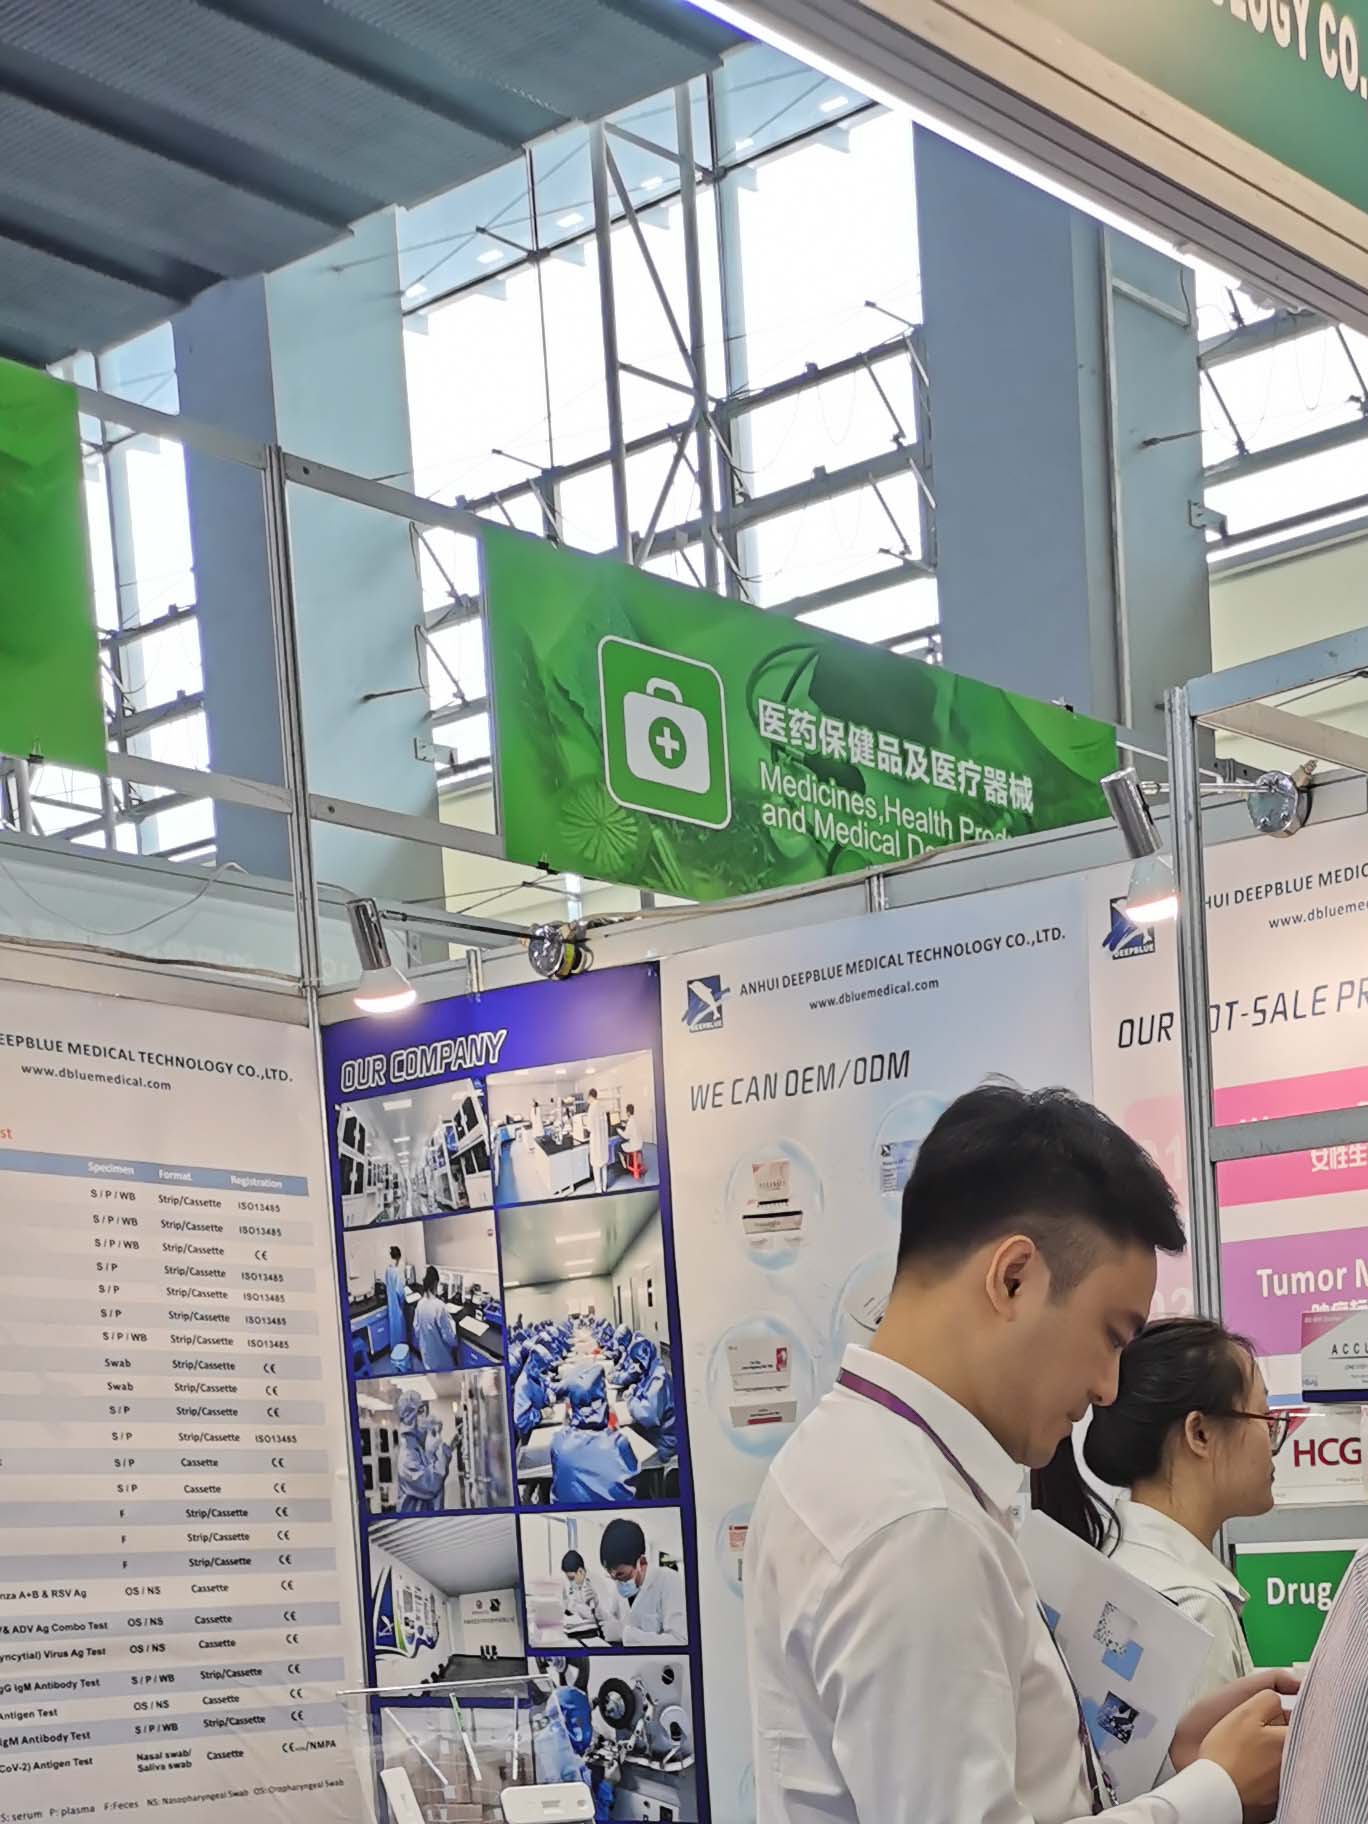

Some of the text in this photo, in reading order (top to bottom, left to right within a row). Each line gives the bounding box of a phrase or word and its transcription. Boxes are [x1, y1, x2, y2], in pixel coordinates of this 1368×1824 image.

[757, 697, 1035, 814] 医药保健品及医疗器械
[762, 802, 806, 833] and
[814, 809, 900, 858] Medical
[1203, 889, 1231, 911] HUI
[1234, 874, 1314, 906] DEEPBLUE
[739, 926, 1066, 997] ANHUI DEEPBLUE MEDICAL TECHNOLOGY CO.,LTD.
[808, 977, 940, 1011] www.dbluemedical.com
[1118, 1011, 1175, 1049] OUR
[1208, 983, 1329, 1034] OT-SALE
[68, 1041, 136, 1063] MEDICAL
[138, 1050, 234, 1075] TECHNOLOGY
[237, 1063, 294, 1083] CO.,LTD.
[341, 1029, 508, 1093] OUR COMPANY
[21, 1063, 172, 1091] www.dbluemedical.com
[690, 1049, 911, 1112] WE CAN OEM/ODM
[88, 1161, 284, 1190] Specimen Format Registration
[159, 1194, 221, 1208] Strip/Cassette
[161, 1219, 223, 1232] Strip/Cassette
[163, 1243, 224, 1255] Strip/Cassette
[164, 1266, 226, 1277] Strip/Cassette
[1256, 1263, 1348, 1298] Tumor
[166, 1287, 228, 1298] Strip/Cassette
[169, 1311, 230, 1322] Strip/Cassette
[171, 1335, 233, 1345] Strip/Cassette
[105, 1359, 235, 1370] Swab Strip/Cassette
[107, 1382, 237, 1393] Swab Strip/Cassette
[176, 1407, 238, 1416] Strip/Cassette
[178, 1432, 240, 1442] Strip/Cassette
[1293, 1437, 1362, 1467] HCG
[181, 1458, 218, 1467] Cassette
[184, 1485, 221, 1493] Cassette
[186, 1508, 248, 1519] Strip/Cassette
[187, 1533, 250, 1543] Strip/Cassette
[189, 1558, 251, 1567] Strip/Cassette
[42, 1590, 48, 1598] &
[51, 1589, 71, 1598] RSV
[74, 1589, 86, 1598] Ag
[191, 1584, 229, 1593] Cassette
[1266, 1577, 1333, 1609] Drug
[12, 1625, 33, 1633] ADV
[36, 1625, 49, 1634] Ag
[51, 1624, 86, 1632] Combo
[195, 1616, 232, 1624] Cassette
[71, 1649, 83, 1658] Ag
[199, 1640, 236, 1648] Cassette
[14, 1683, 31, 1693] IgM
[34, 1681, 77, 1690] Antibody
[80, 1679, 100, 1687] Test
[200, 1669, 262, 1680] Strip/Cassette
[38, 1709, 57, 1717] Test
[202, 1695, 239, 1704] Cassette
[22, 1733, 68, 1744] Antibody
[71, 1732, 90, 1740] Test
[203, 1716, 265, 1728] Strip/Cassette
[33, 1761, 70, 1770] Antigen
[73, 1758, 92, 1766] Test
[207, 1750, 244, 1760] Cassette
[137, 1752, 162, 1761] Nasal
[138, 1761, 192, 1772] Saliva swab
[12, 1812, 42, 1821] serum
[61, 1806, 95, 1817] plasma
